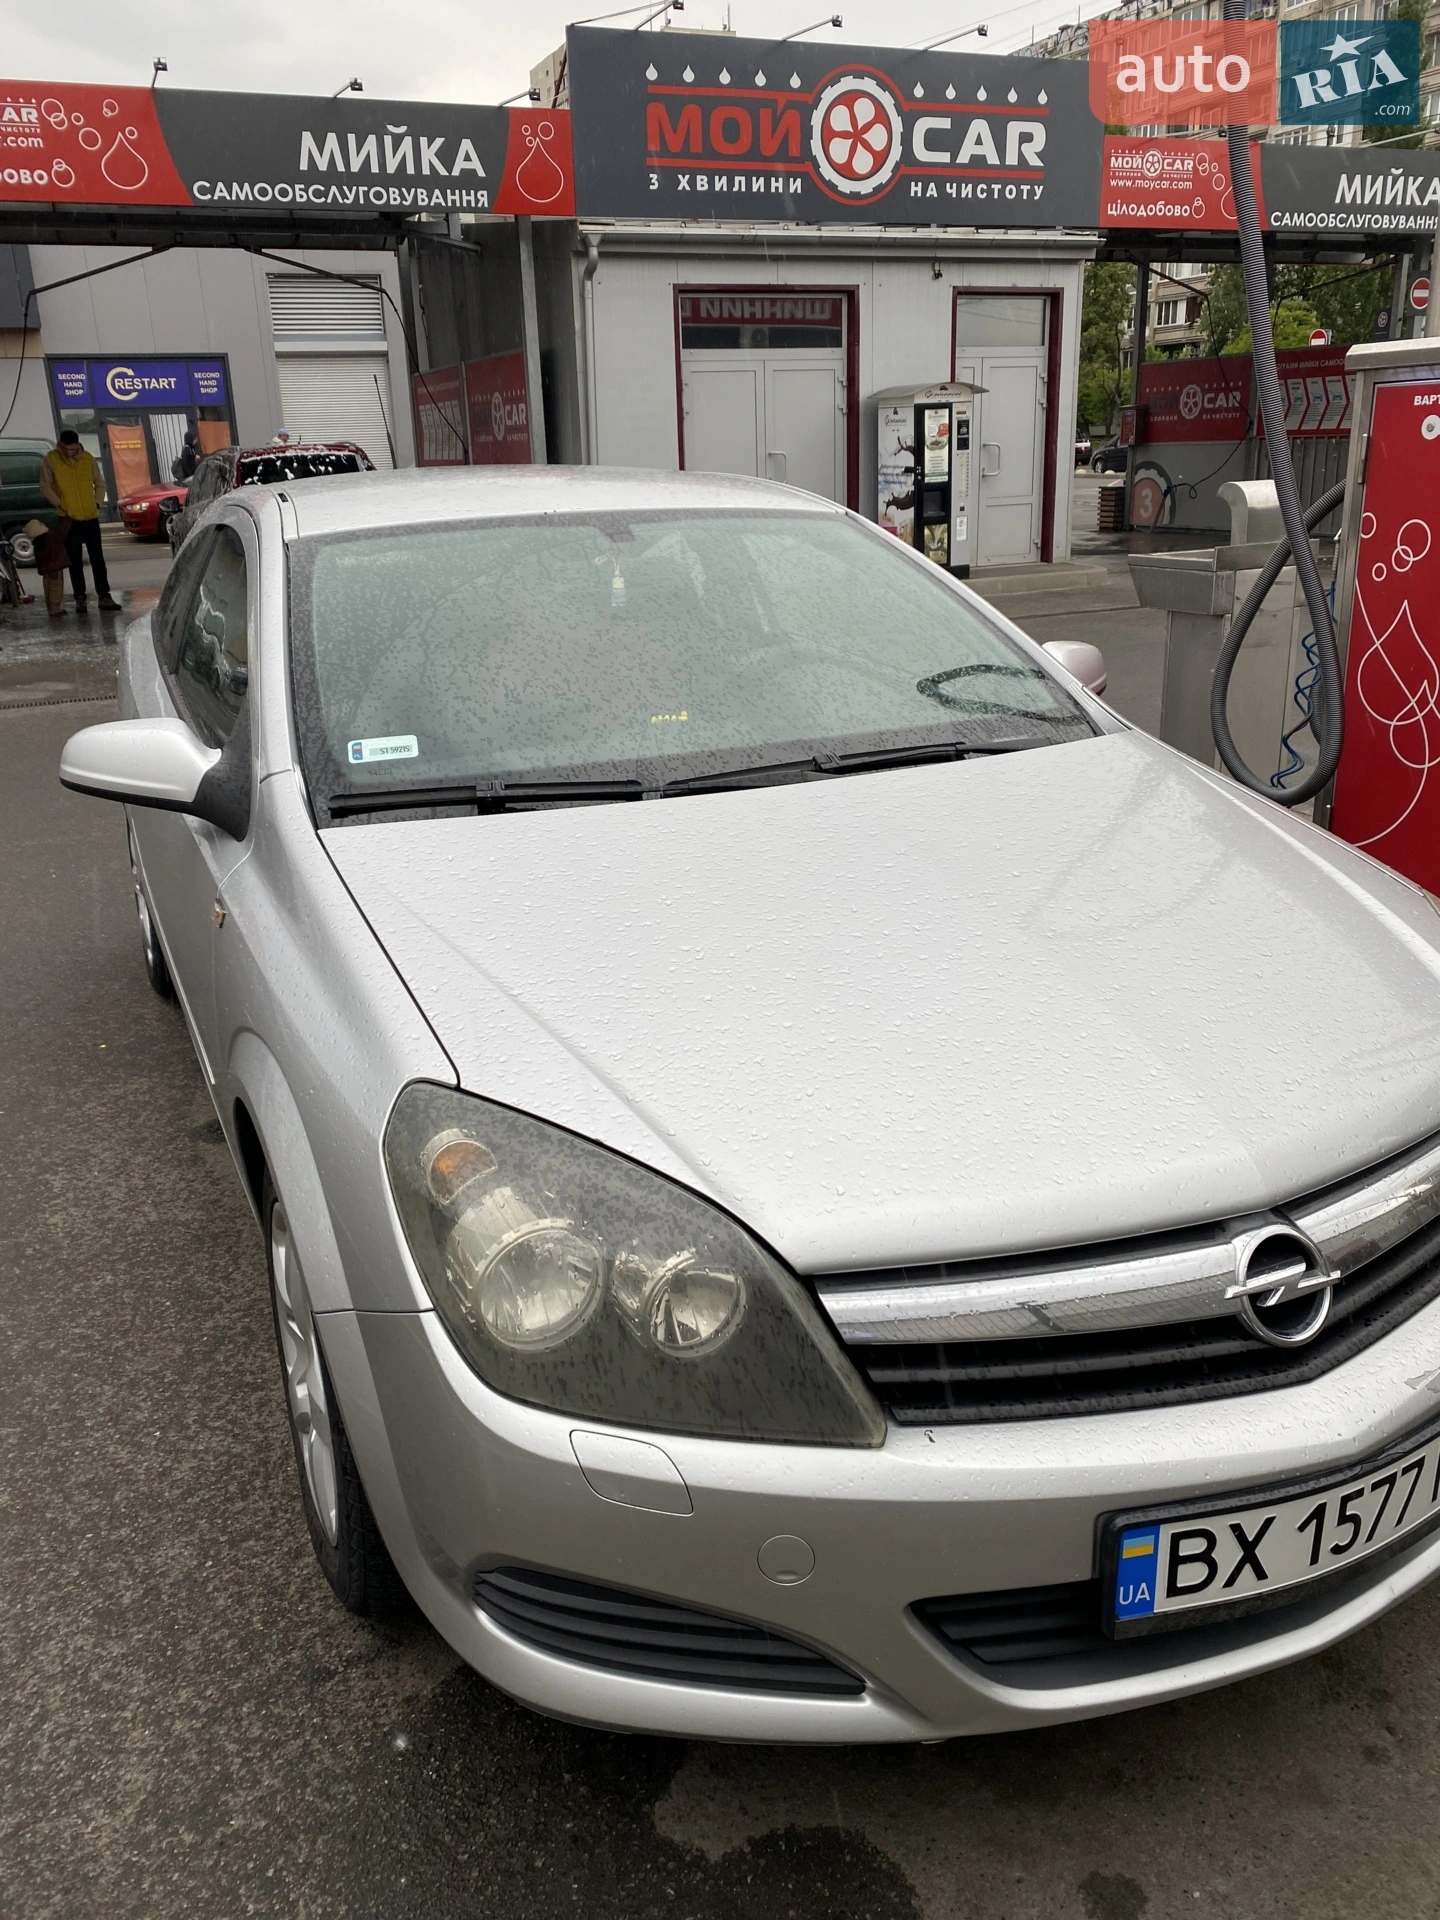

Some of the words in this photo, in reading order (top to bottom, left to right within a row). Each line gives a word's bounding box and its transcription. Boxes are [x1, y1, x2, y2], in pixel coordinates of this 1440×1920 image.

[0, 106, 39, 123] AR
[646, 99, 802, 157] МОЙ
[911, 115, 1048, 167] CAR
[299, 122, 487, 178] МИЙКА
[1110, 155, 1142, 169] МОЙ
[1163, 158, 1194, 171] CAR
[192, 180, 489, 208] САМООБСЛУГОВУВАННЯ
[648, 174, 660, 190] 3
[677, 174, 803, 194] ХВИЛИНИ
[910, 181, 938, 198] НА
[945, 182, 1045, 200] ЧИСТОТУ
[1109, 178, 1193, 190] www.moycar.com
[1334, 167, 1440, 207] МИЙКА
[1107, 199, 1191, 217] цілодобово
[114, 377, 177, 390] RESTART
[1203, 391, 1242, 409] CAR
[504, 403, 527, 426] CAR
[1140, 487, 1153, 518] 3
[1166, 1514, 1276, 1599] BX
[1296, 1453, 1426, 1567] 1577
[1118, 1581, 1151, 1606] UA
